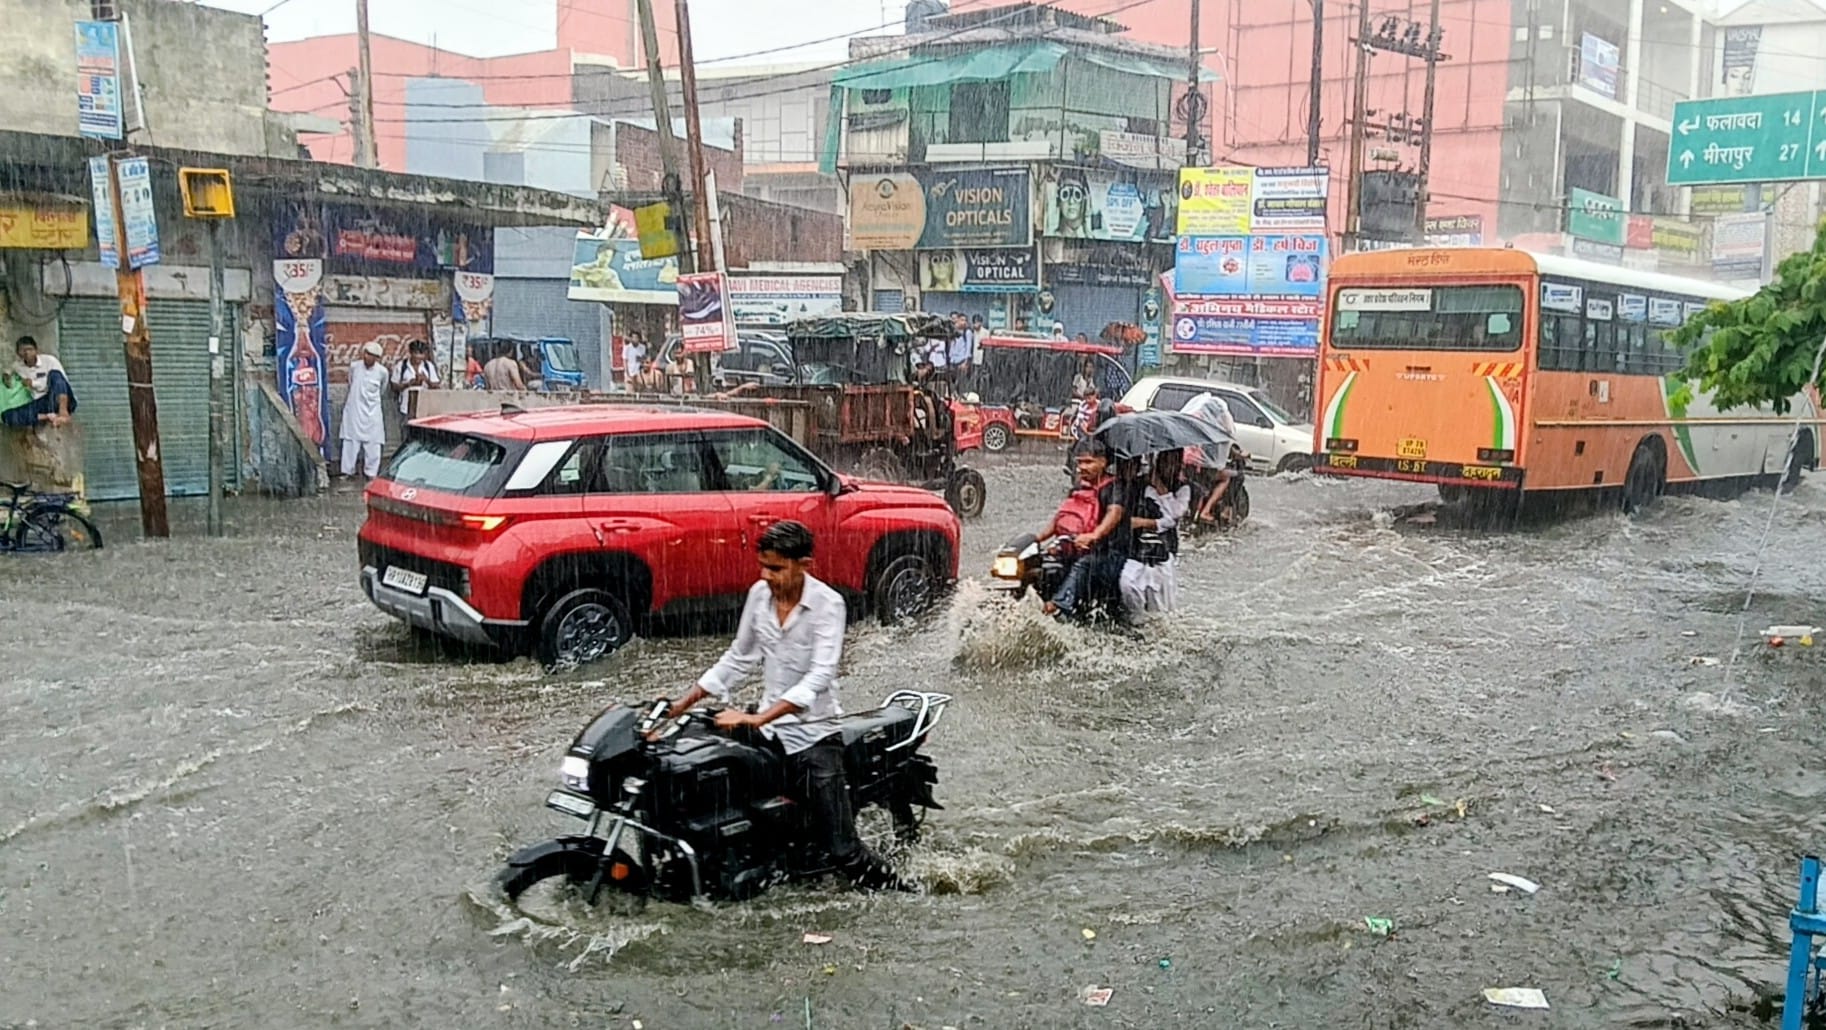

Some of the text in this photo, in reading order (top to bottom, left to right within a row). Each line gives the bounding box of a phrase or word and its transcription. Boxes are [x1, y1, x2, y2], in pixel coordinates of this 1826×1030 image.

[1706, 109, 1801, 131] फलावदा 14
[1703, 142, 1799, 170] मीरापुर 27
[954, 187, 1003, 204] VISION
[946, 209, 1012, 226] OPTICALS
[976, 266, 1024, 279] OPTICAL
[750, 279, 793, 292] MEDICAL
[794, 279, 840, 292] AGENCIES
